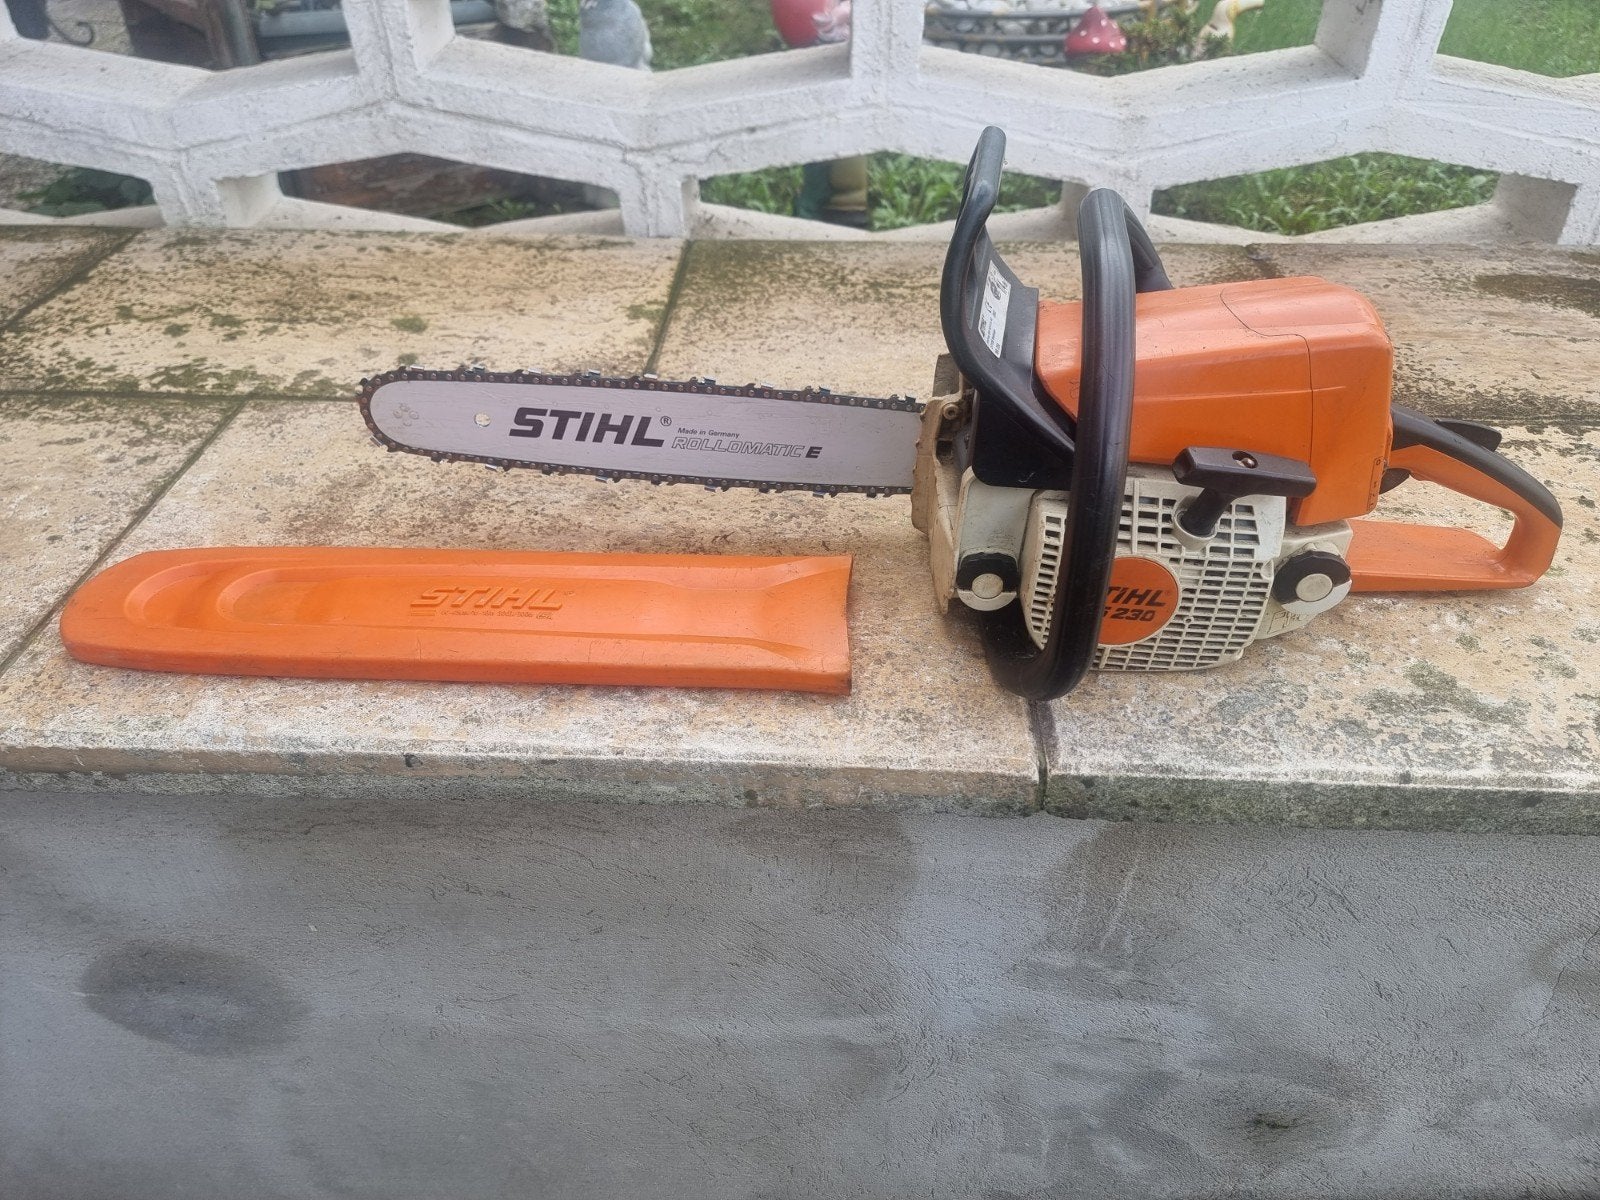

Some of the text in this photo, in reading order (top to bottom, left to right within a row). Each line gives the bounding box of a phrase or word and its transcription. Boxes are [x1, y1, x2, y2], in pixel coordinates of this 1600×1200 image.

[677, 427, 698, 436] Made
[708, 429, 740, 440] Germany
[671, 436, 823, 459] ROLLOMATIC E
[410, 587, 563, 611] STIHL
[1107, 586, 1167, 607] TIHL
[1110, 607, 1156, 622] 230
